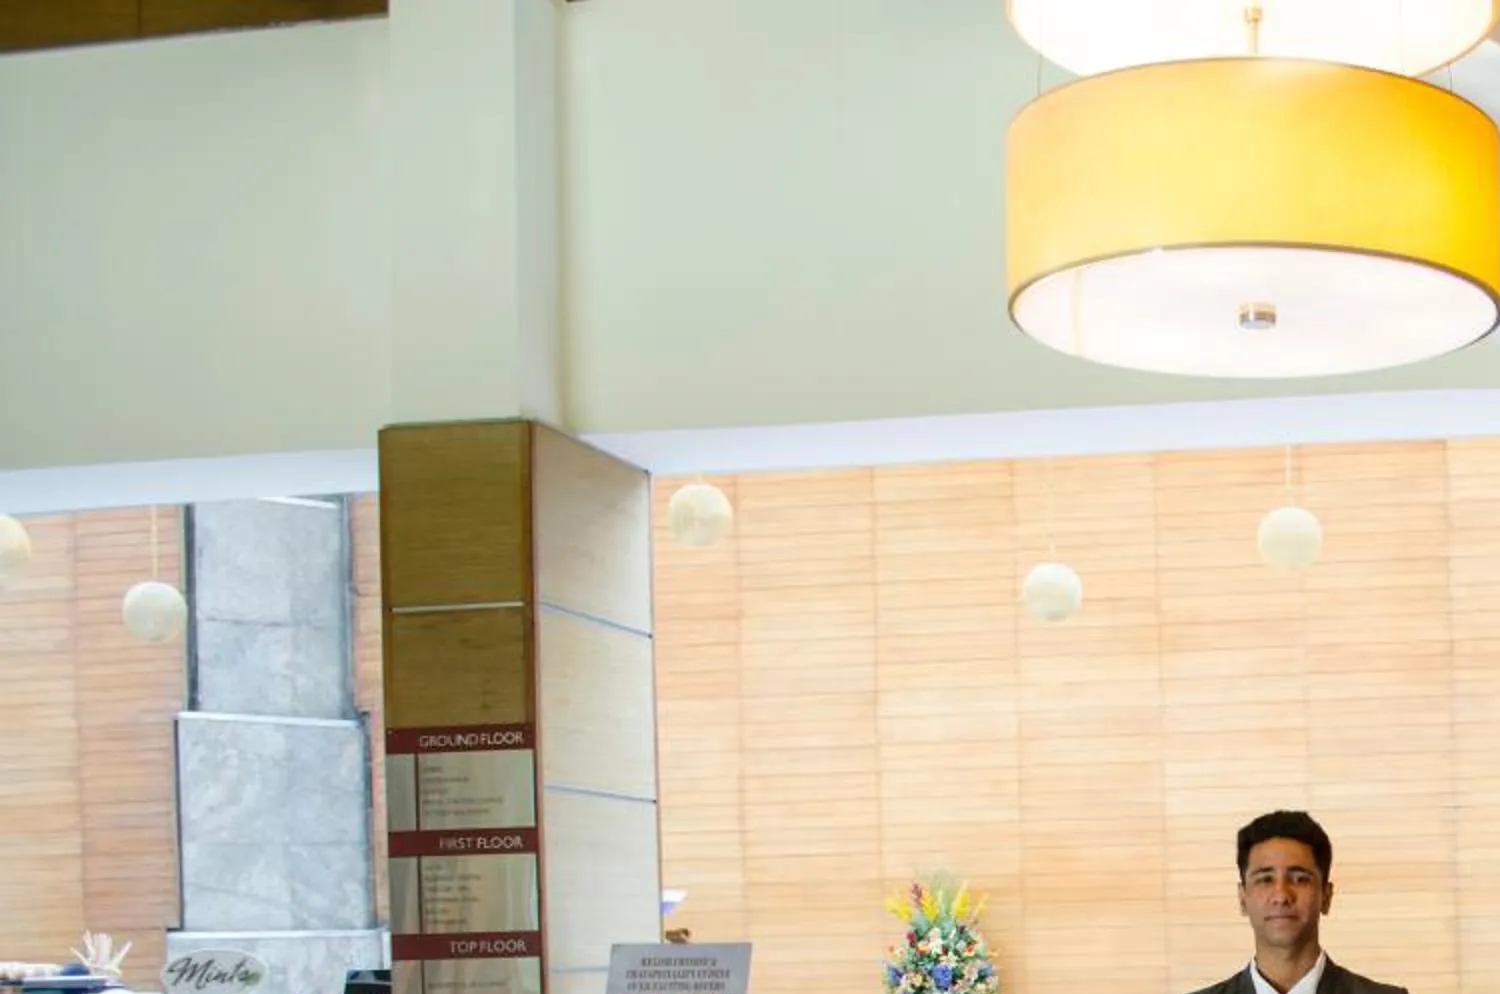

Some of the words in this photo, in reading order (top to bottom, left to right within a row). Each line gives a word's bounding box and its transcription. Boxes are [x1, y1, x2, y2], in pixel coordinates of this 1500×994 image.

[420, 734, 479, 748] GROUND
[480, 731, 524, 746] FLOOR
[439, 838, 472, 849] FIRST
[476, 836, 523, 849] FLOOR
[450, 940, 477, 953] TOP
[479, 938, 527, 953] FLOOR
